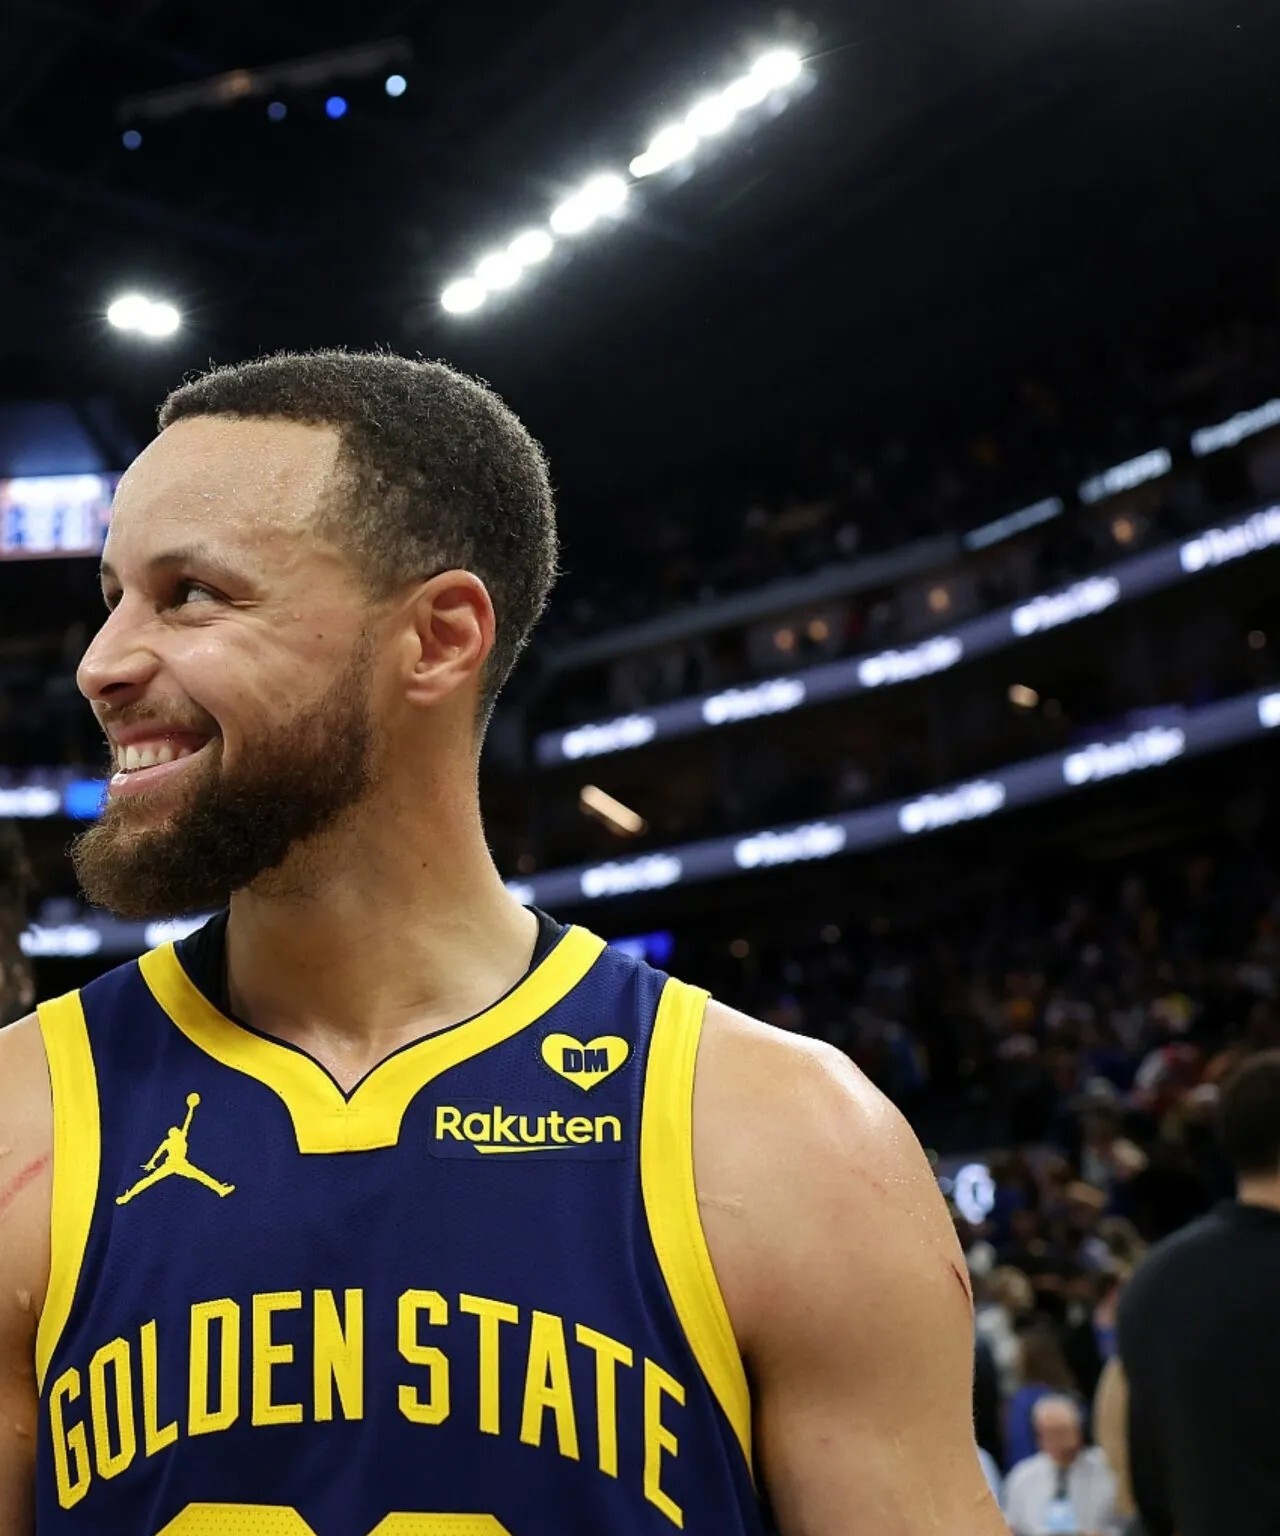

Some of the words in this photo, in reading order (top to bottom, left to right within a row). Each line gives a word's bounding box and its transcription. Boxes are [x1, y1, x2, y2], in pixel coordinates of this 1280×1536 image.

[562, 1047, 610, 1074] DM
[435, 1105, 622, 1144] Rakuten
[48, 1288, 364, 1510] GOLDEN
[397, 1288, 687, 1530] STATE
